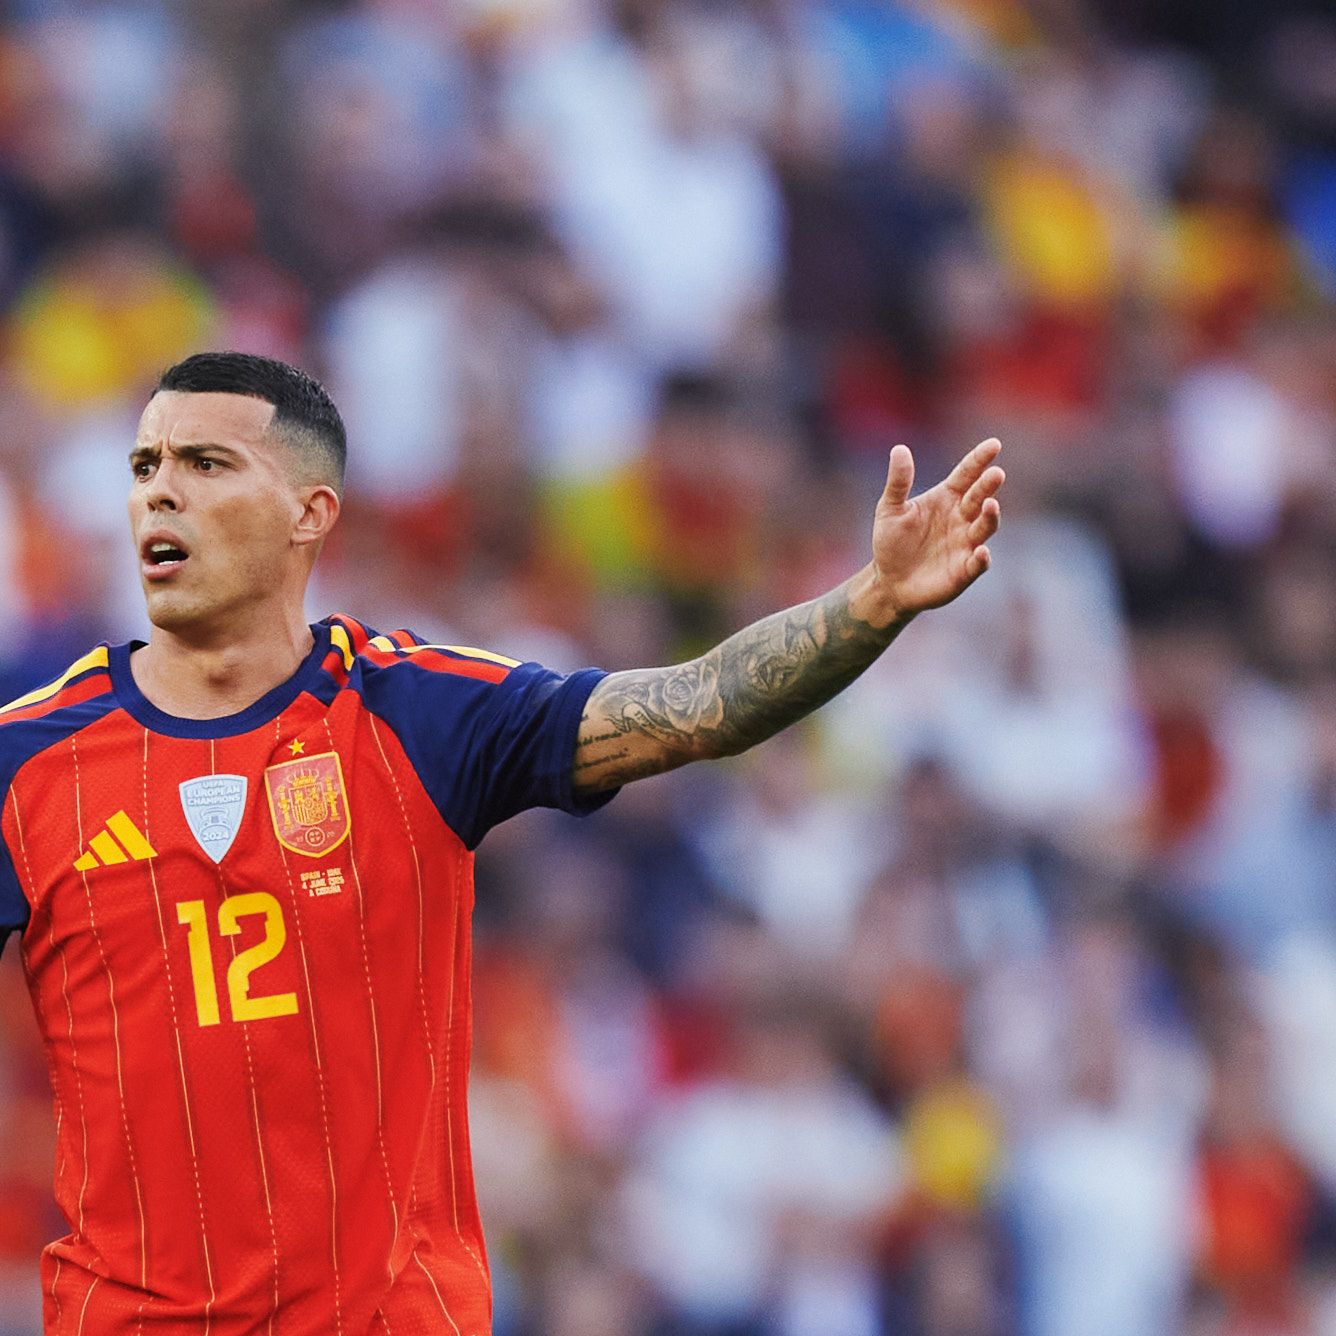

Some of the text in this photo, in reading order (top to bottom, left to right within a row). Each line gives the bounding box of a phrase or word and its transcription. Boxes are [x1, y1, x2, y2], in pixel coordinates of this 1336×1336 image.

[187, 785, 241, 798] EUROPEAN
[188, 795, 241, 806] CHAMPIONS
[176, 891, 299, 1027] 12
